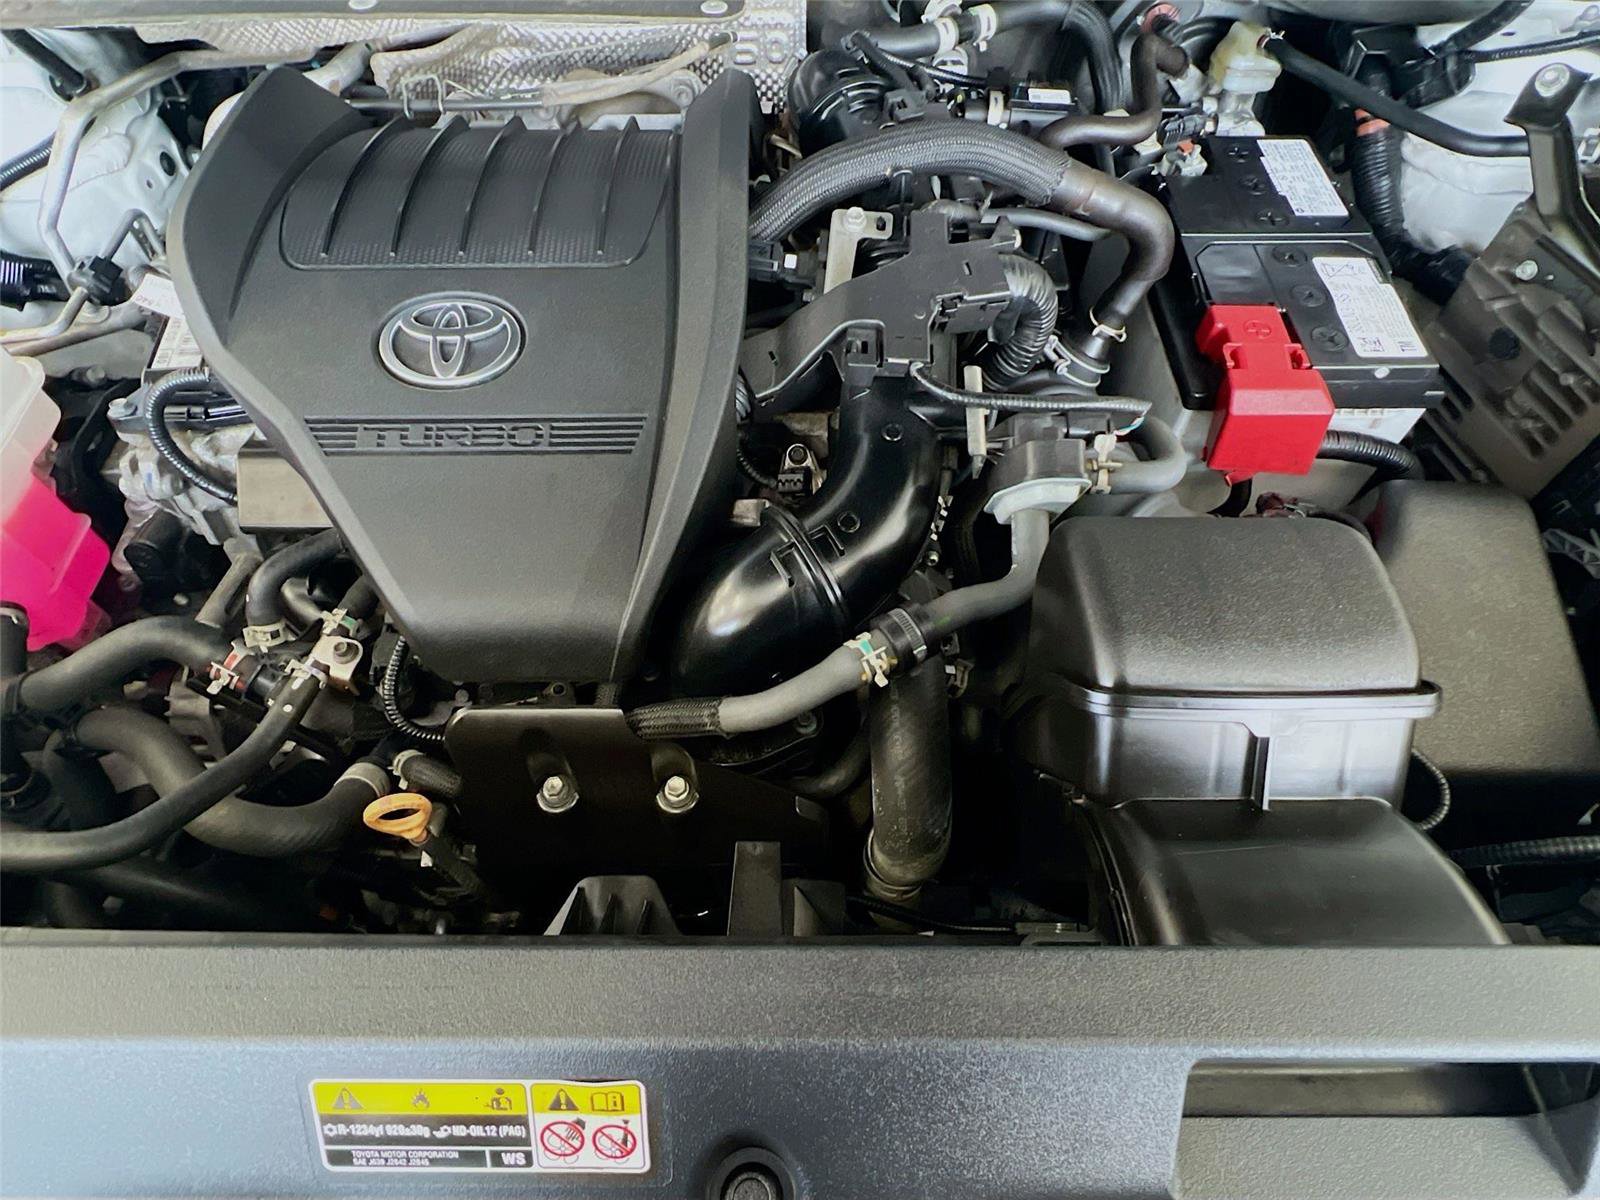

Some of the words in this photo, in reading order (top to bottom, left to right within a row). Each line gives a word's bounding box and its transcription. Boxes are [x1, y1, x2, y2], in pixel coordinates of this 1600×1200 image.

[363, 424, 544, 448] TURBO
[499, 1125, 526, 1138] (PAG)
[351, 1150, 379, 1158] TOYOTA
[382, 1150, 407, 1158] MOTOR
[408, 1150, 459, 1159] CORPORATION
[501, 1152, 526, 1166] WS
